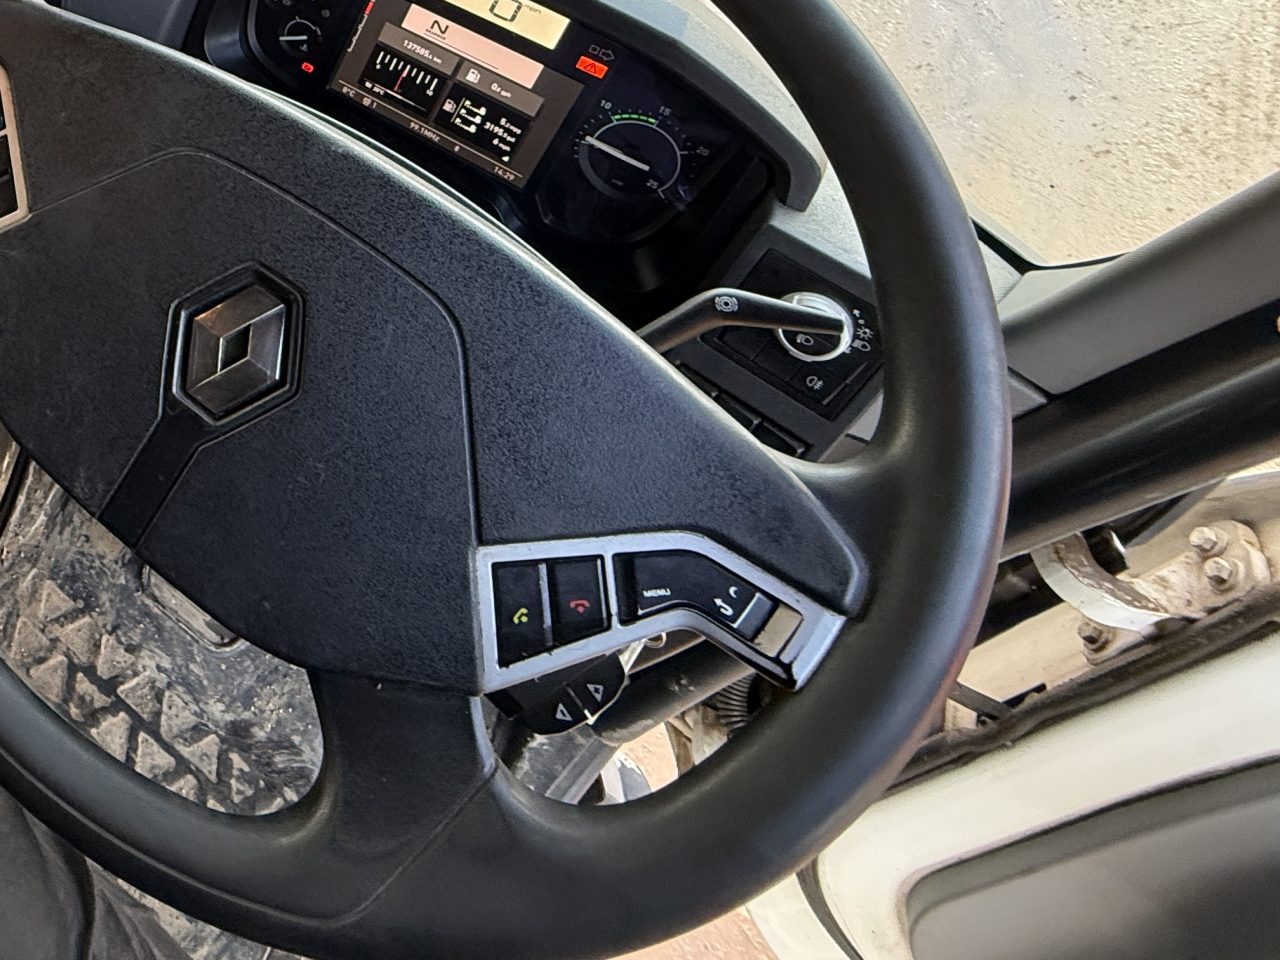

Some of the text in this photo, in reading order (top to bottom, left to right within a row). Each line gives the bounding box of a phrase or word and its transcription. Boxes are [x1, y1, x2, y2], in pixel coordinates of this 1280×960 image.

[523, 3, 542, 15] mph
[430, 19, 449, 35] N
[599, 99, 613, 110] 10
[658, 105, 671, 116] 15
[695, 146, 710, 157] 20
[646, 178, 660, 189] 25
[642, 587, 671, 598] MENU
